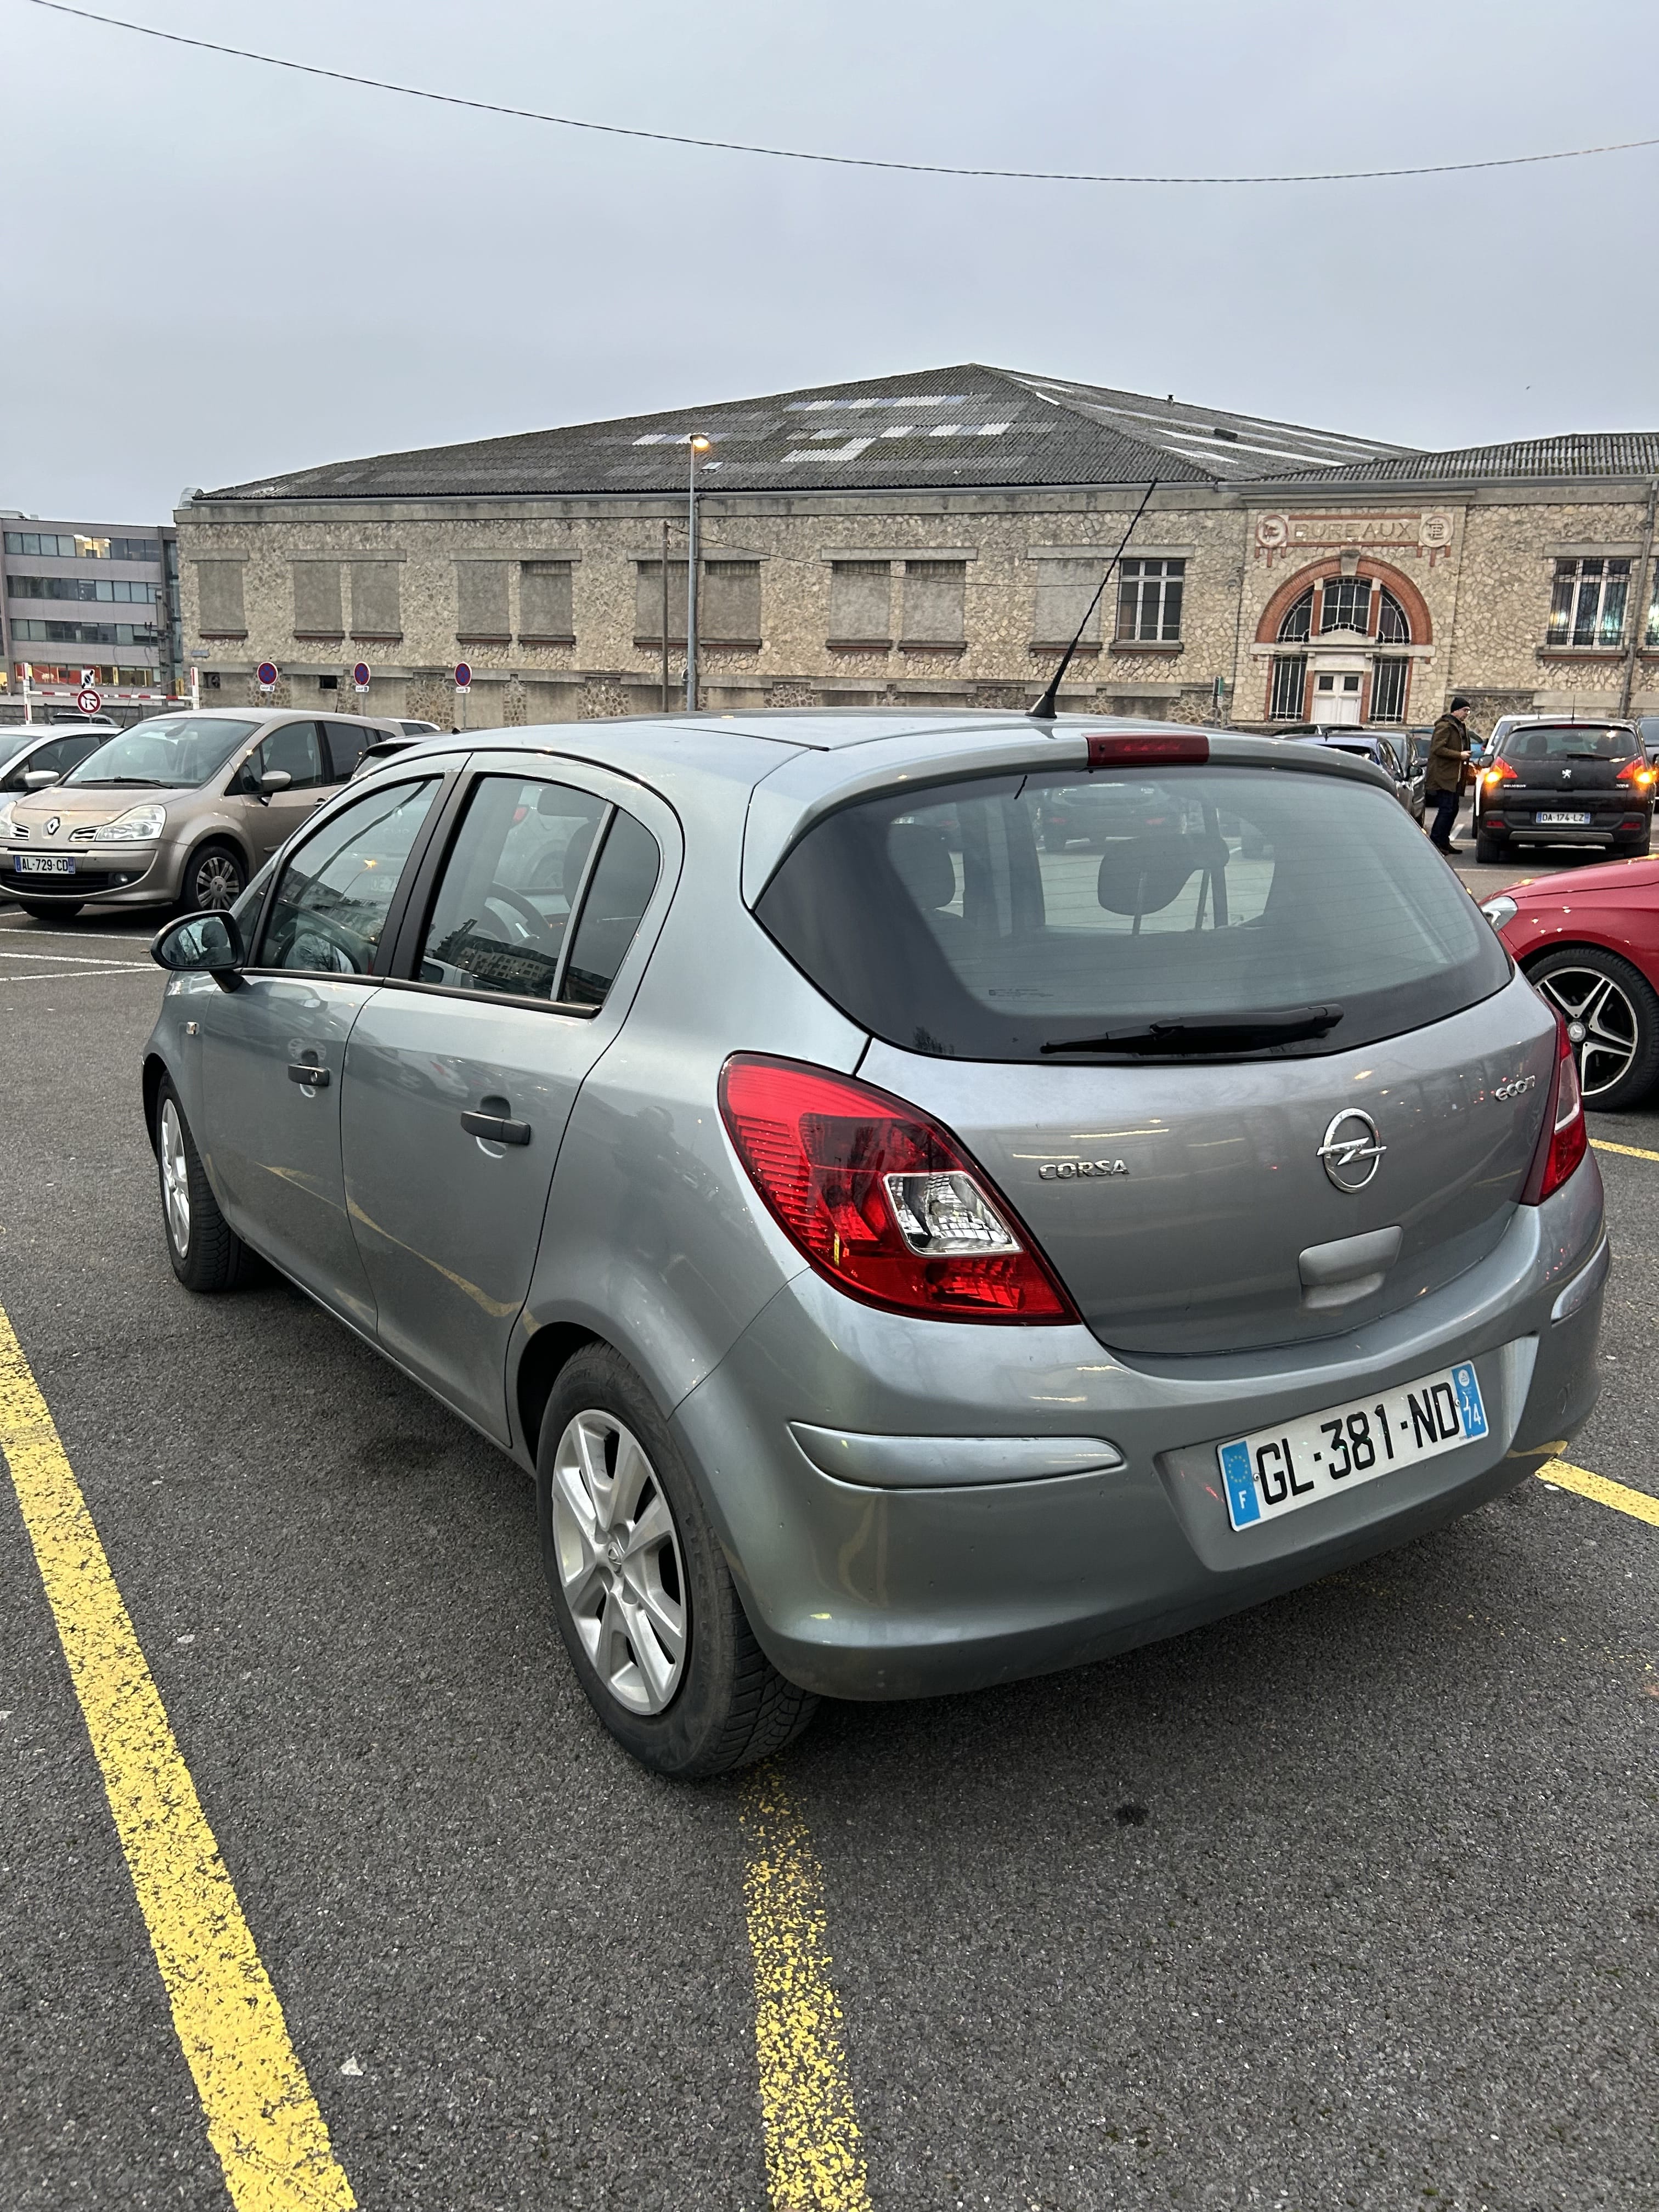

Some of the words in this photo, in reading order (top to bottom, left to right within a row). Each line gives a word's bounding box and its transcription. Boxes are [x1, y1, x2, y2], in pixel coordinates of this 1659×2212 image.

[1294, 522, 1412, 540] BUREAUX
[22, 858, 69, 871] AL-729-CD
[1039, 1159, 1130, 1180] CORSA
[1256, 1381, 1460, 1506] GL-381-ND
[1238, 1489, 1248, 1510] F
